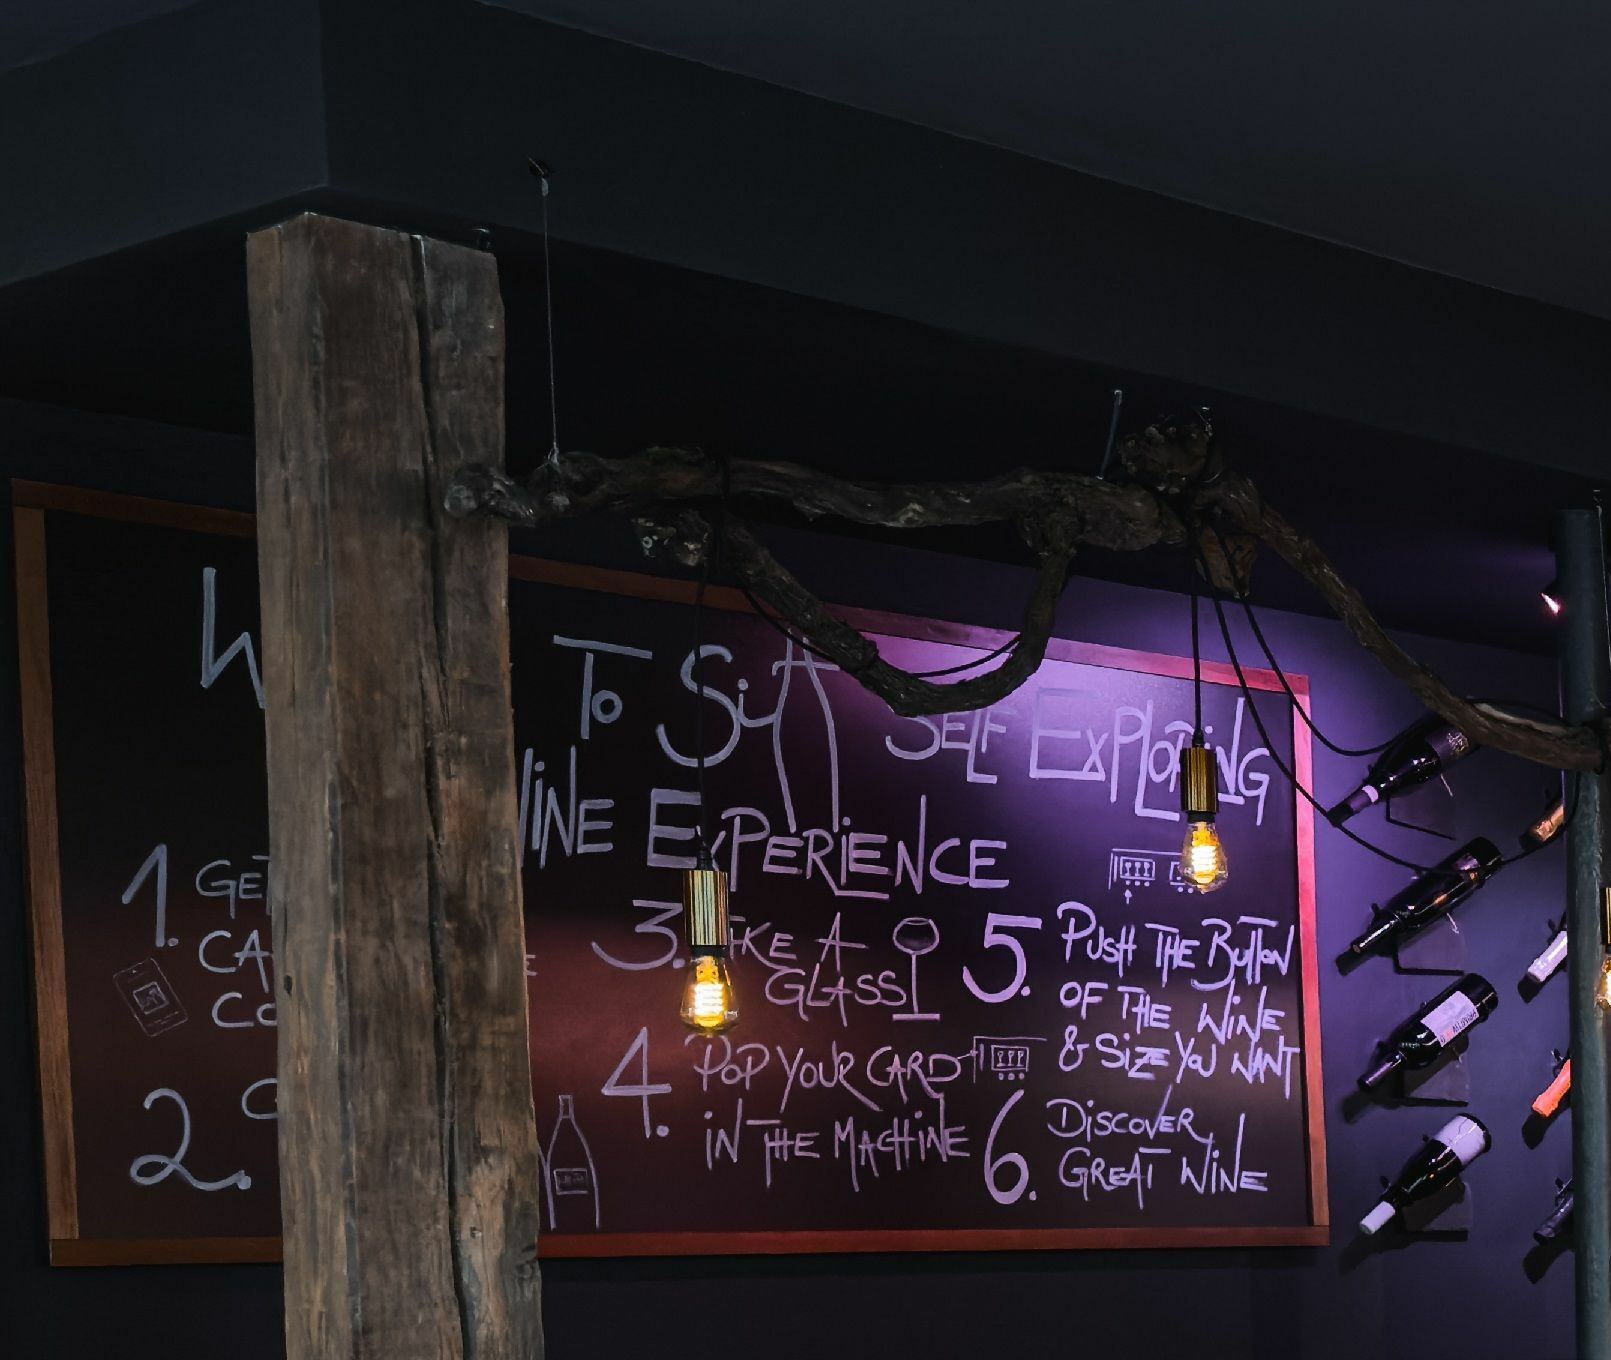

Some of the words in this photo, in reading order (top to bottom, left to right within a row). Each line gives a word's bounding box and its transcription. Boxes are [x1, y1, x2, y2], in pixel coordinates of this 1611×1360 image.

[121, 844, 179, 948] 1.
[592, 899, 687, 971] 3.
[817, 912, 868, 972] A
[962, 912, 1043, 1004] 5.
[1056, 901, 1137, 978] PUSH
[1144, 922, 1201, 987] THE
[765, 962, 907, 1026] GLASS
[1059, 981, 1109, 1020] OF
[1117, 985, 1172, 1034] THE
[602, 1026, 672, 1139] 4.
[776, 1041, 884, 1111] YOUR
[867, 1045, 962, 1104] CARD
[1058, 1025, 1090, 1072] &
[1230, 1035, 1301, 1100] WANT
[130, 1087, 251, 1191] 2.
[746, 1119, 820, 1189] THE
[984, 1089, 1037, 1204] 6.
[1058, 1146, 1172, 1210] GREAT
